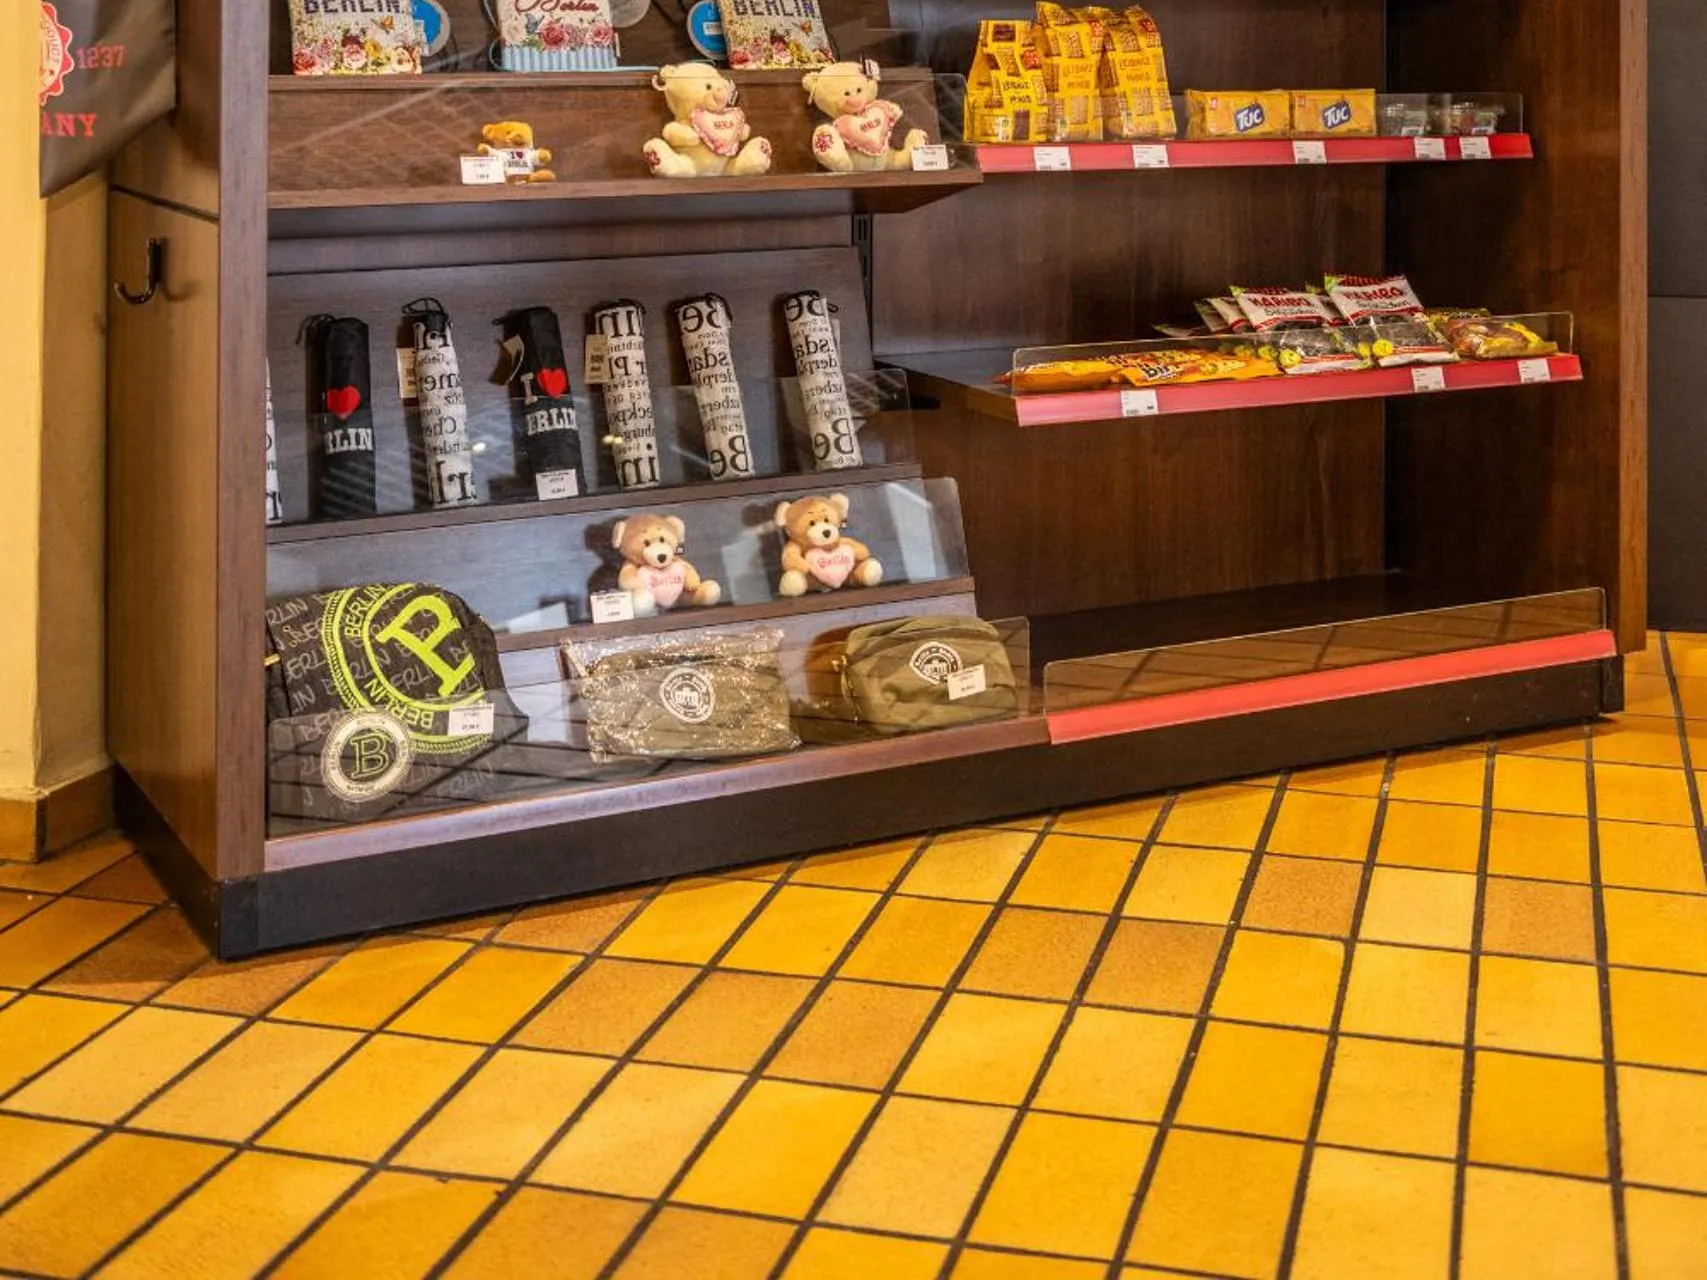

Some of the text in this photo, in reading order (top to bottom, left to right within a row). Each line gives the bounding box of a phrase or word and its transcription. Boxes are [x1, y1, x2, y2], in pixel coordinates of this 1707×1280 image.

[76, 45, 125, 69] 1237
[1248, 295, 1311, 308] HARIBO
[1343, 286, 1404, 302] HARIBO
[345, 584, 387, 638] BERLIN
[364, 678, 434, 729] BERLIN
[349, 733, 389, 780] B
